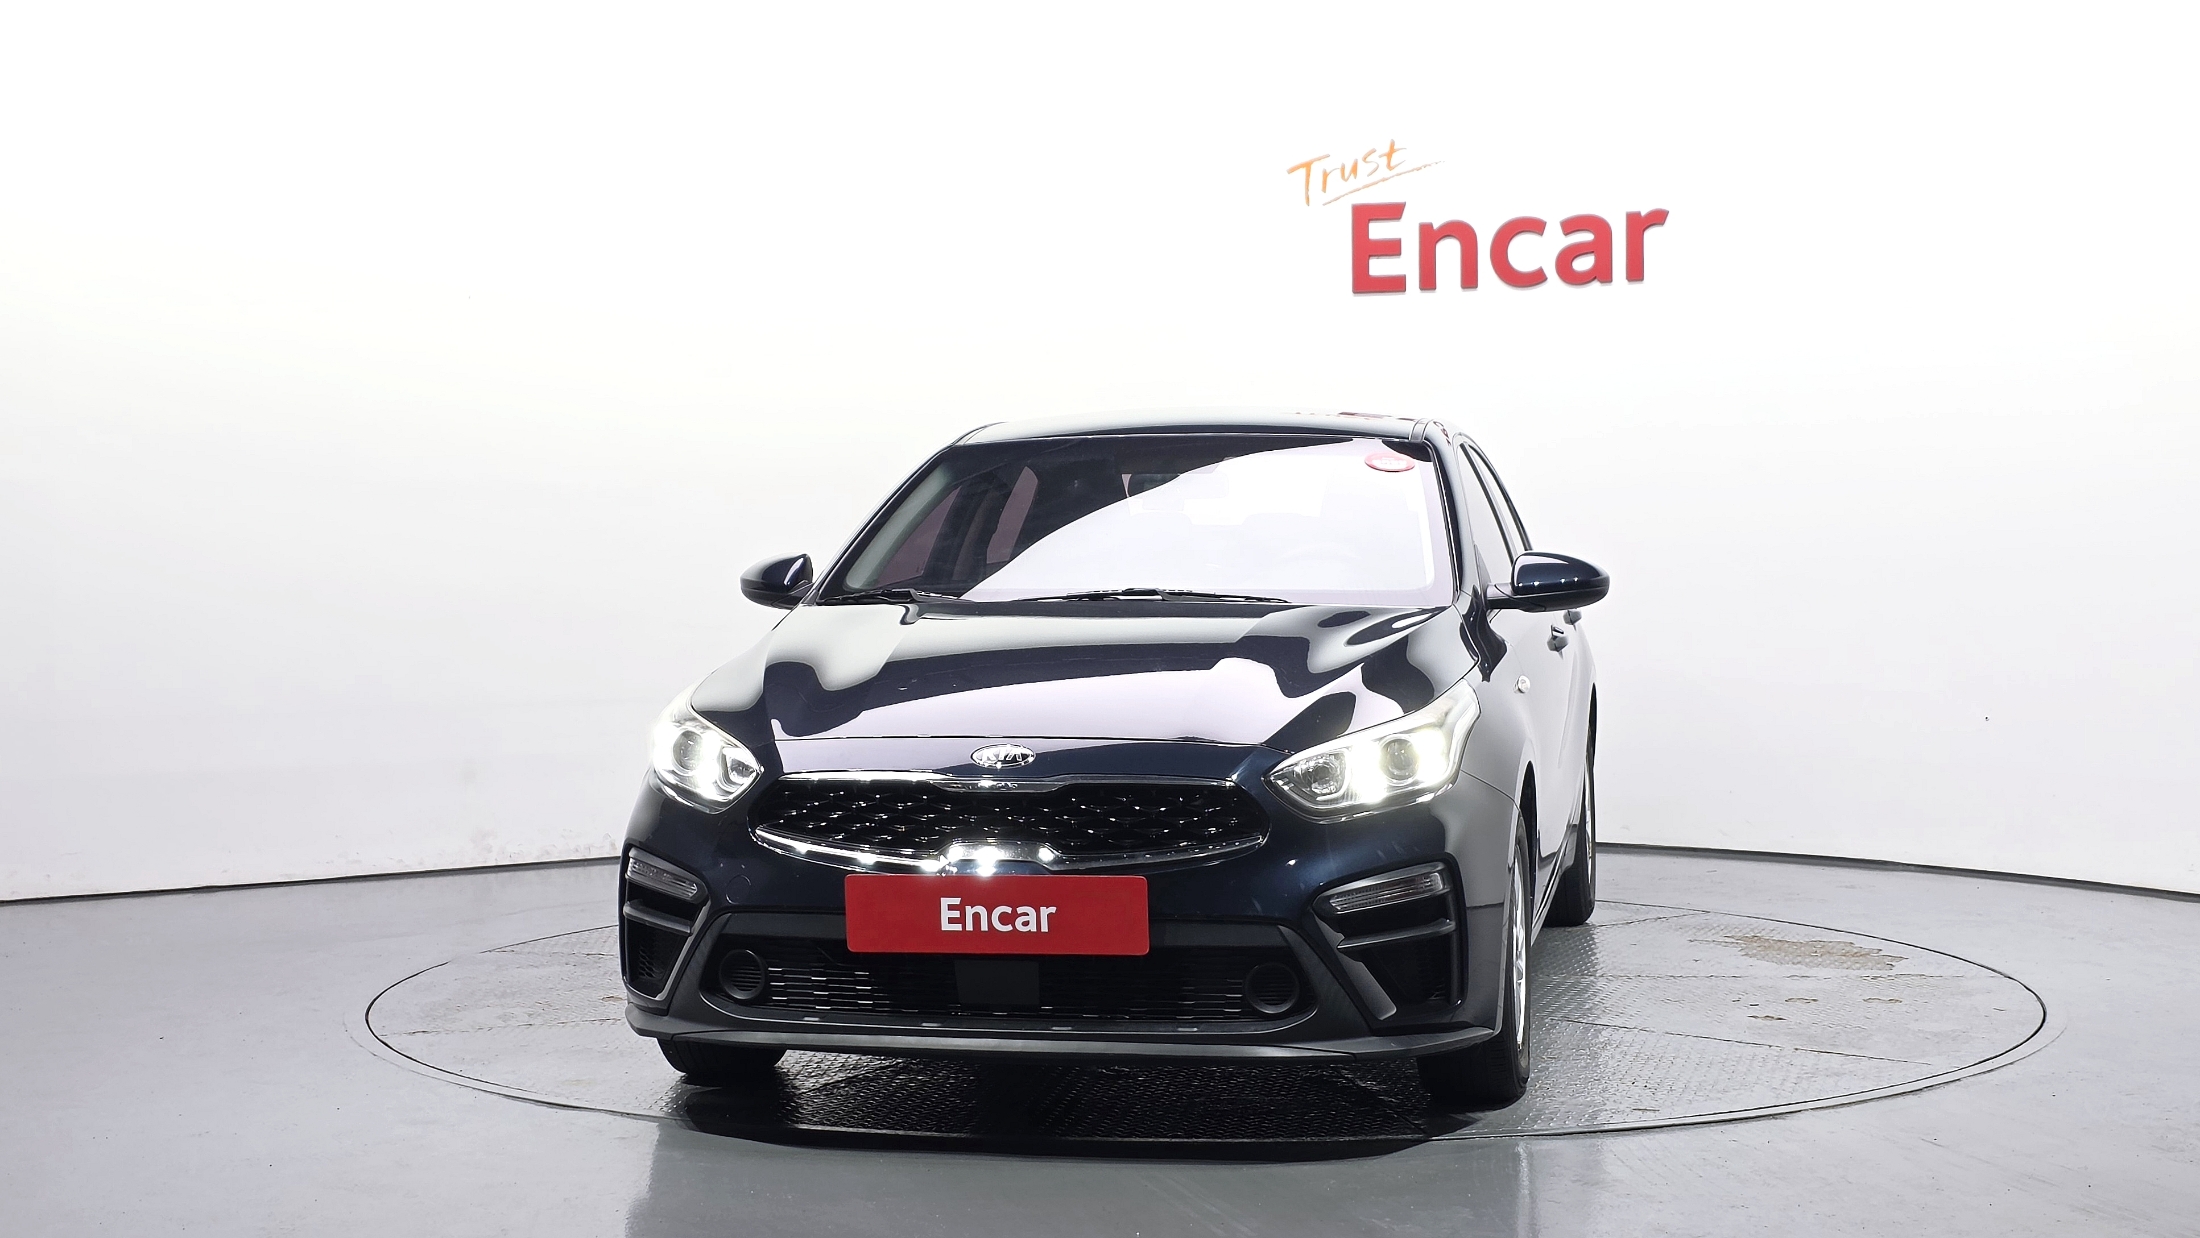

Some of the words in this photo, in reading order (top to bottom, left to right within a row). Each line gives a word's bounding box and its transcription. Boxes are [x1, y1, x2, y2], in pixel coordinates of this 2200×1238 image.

[1287, 139, 1407, 206] Trust
[1351, 201, 1669, 294] Encar
[940, 897, 1056, 933] Encar
